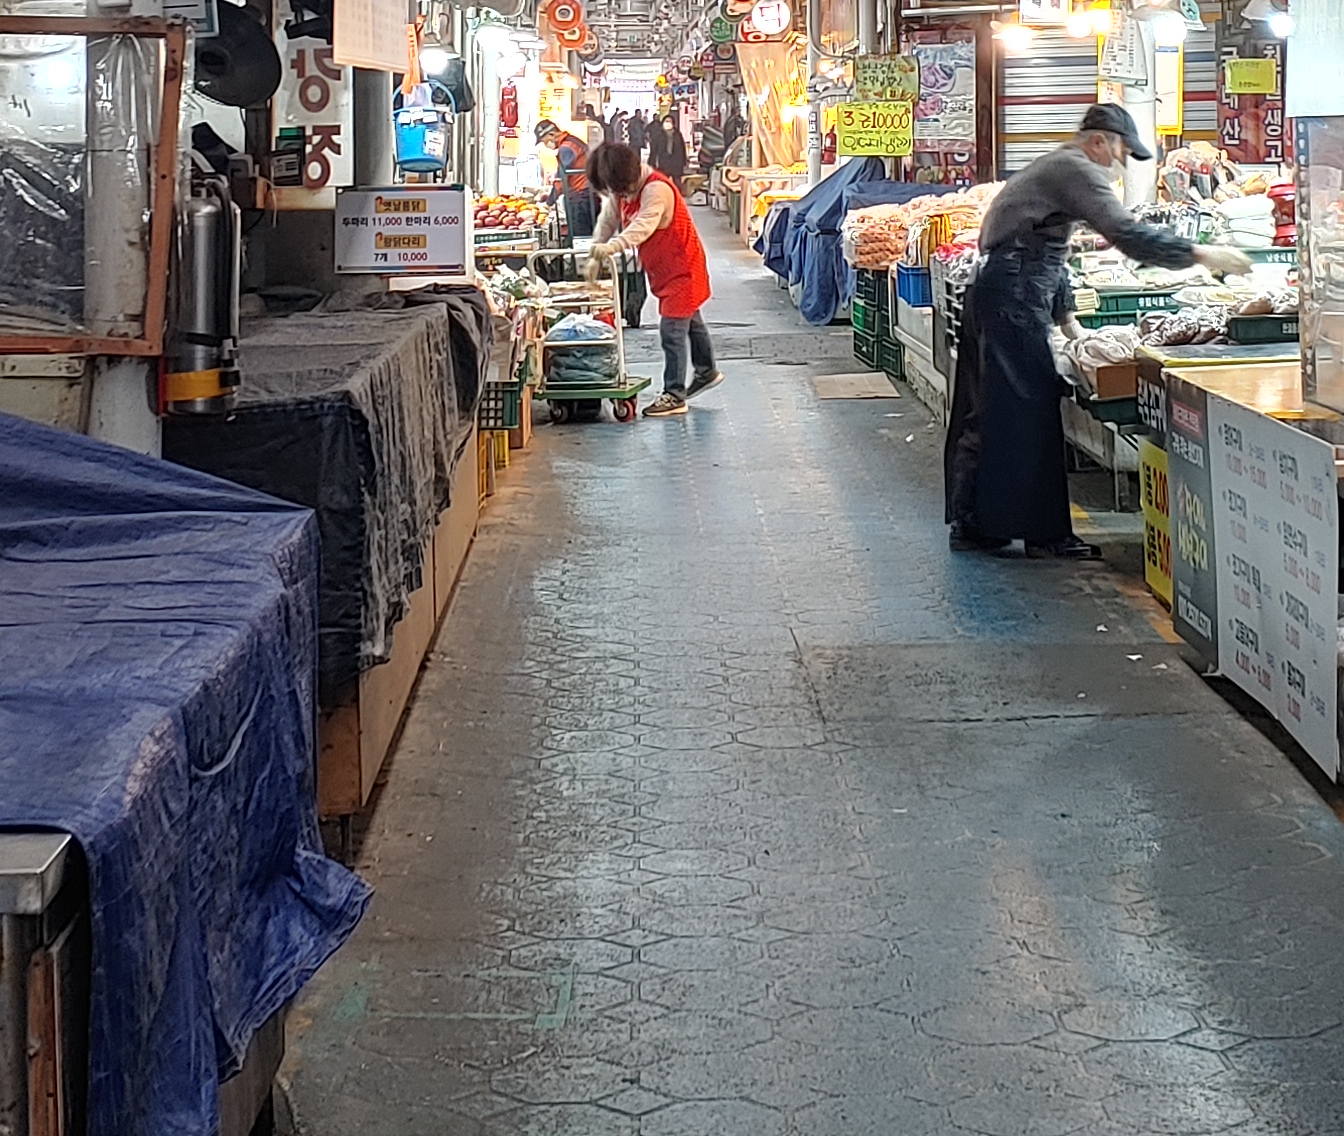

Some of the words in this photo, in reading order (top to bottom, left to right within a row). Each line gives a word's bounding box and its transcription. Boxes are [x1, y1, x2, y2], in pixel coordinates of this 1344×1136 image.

[342, 216, 369, 227] 두마리
[372, 216, 402, 227] 11,000
[405, 215, 431, 226] 한마리
[434, 215, 459, 226] 6,000
[374, 252, 388, 262] 7개
[398, 252, 428, 262] 10,000
